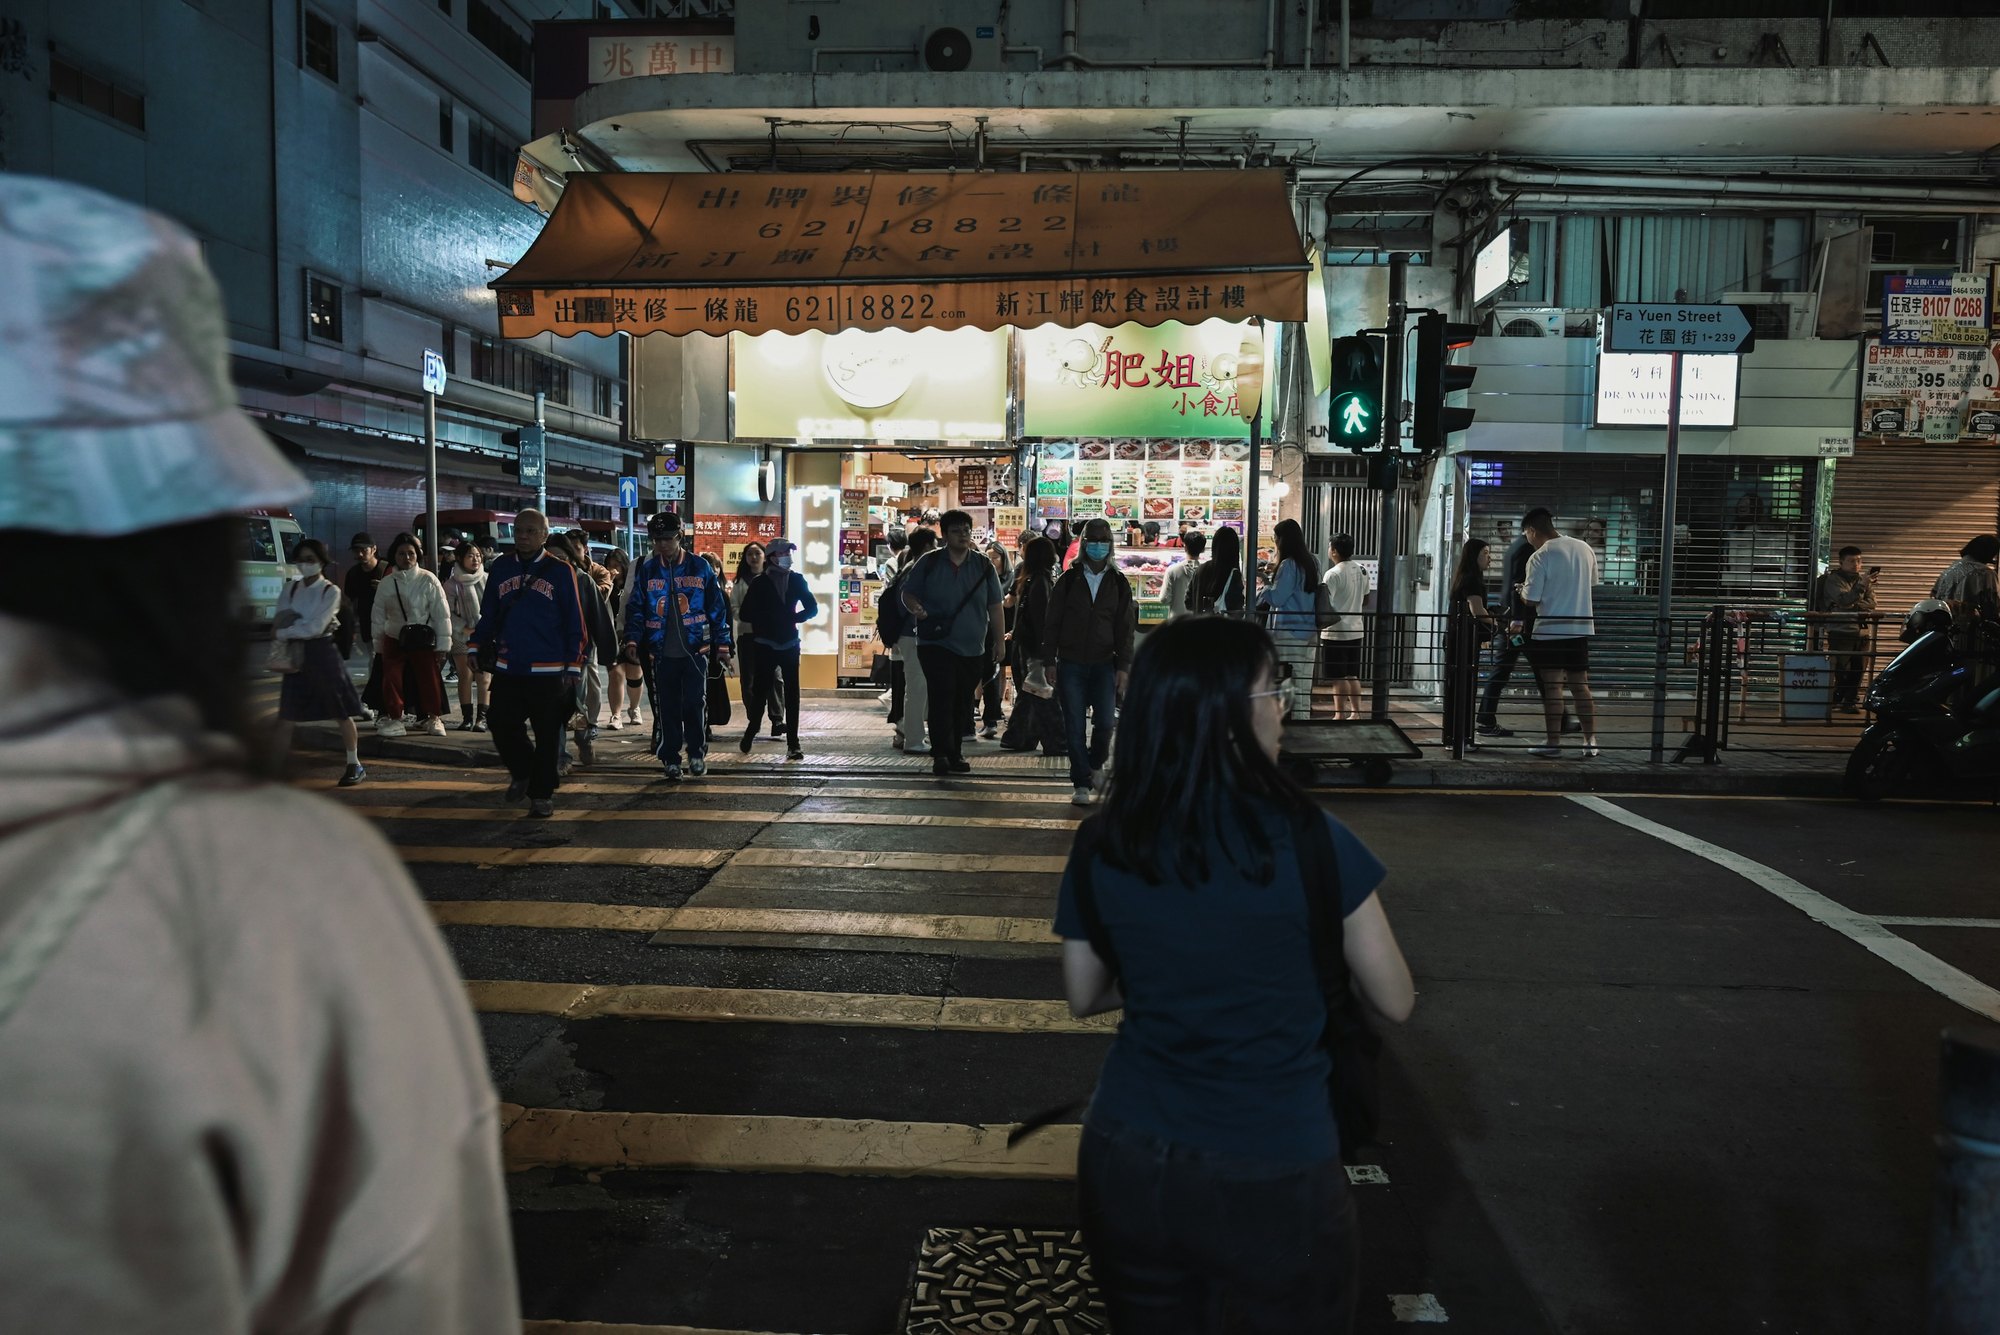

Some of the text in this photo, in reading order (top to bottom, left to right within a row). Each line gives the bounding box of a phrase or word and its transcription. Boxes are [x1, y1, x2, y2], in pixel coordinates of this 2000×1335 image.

[603, 41, 722, 77] 兆萬中
[696, 182, 1141, 210] 出牌裝修一條龍
[758, 215, 1067, 240] 62118822
[631, 237, 1179, 269] 新江輝飲食設計樓
[1970, 287, 1985, 295] 5987
[555, 296, 759, 323] 出牌裝修一條龍
[996, 285, 1246, 317] 新江輝飲食設計樓
[1891, 296, 1922, 314] 任冠宇
[1922, 297, 1982, 317] 8107 0268
[1616, 309, 1722, 323] Fa Yuen Street
[1639, 328, 1736, 345] 花園街 1-239
[1943, 332, 1985, 342] 6108 0624
[1879, 346, 1954, 359] 中原(工商舖)
[1100, 349, 1202, 390] 肥姐
[1630, 366, 1704, 380] 牙科生
[1171, 391, 1241, 417] 小食店
[1926, 433, 1958, 441] 6464 5987
[676, 477, 683, 486] 7
[676, 490, 686, 499] 12
[695, 521, 722, 530] 秀茂坪
[729, 522, 747, 531] 葵芳
[758, 523, 775, 532] 青衣
[498, 575, 522, 600] NEW
[646, 575, 705, 592] EW YORK
